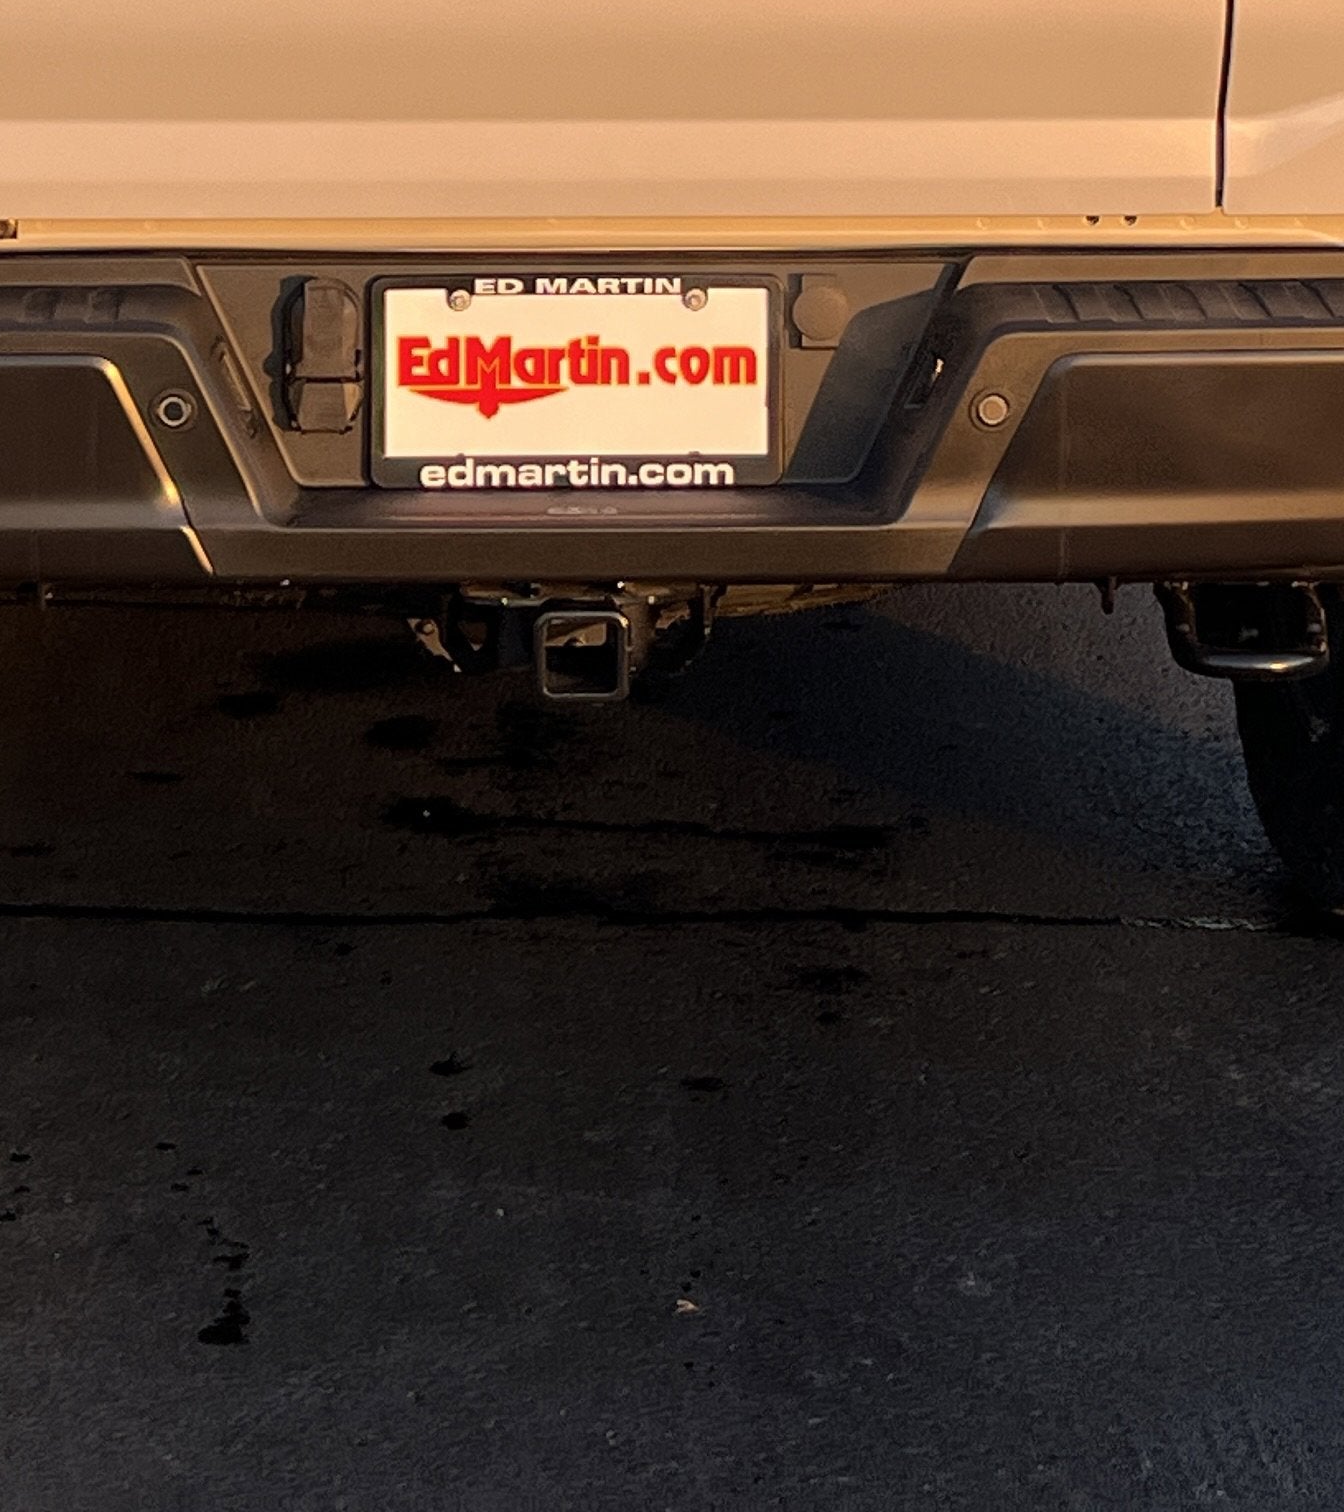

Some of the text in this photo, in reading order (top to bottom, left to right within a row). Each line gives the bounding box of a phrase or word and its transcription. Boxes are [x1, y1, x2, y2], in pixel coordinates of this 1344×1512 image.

[474, 277, 682, 295] ED MARTIN
[419, 458, 735, 487] edmartin.com
